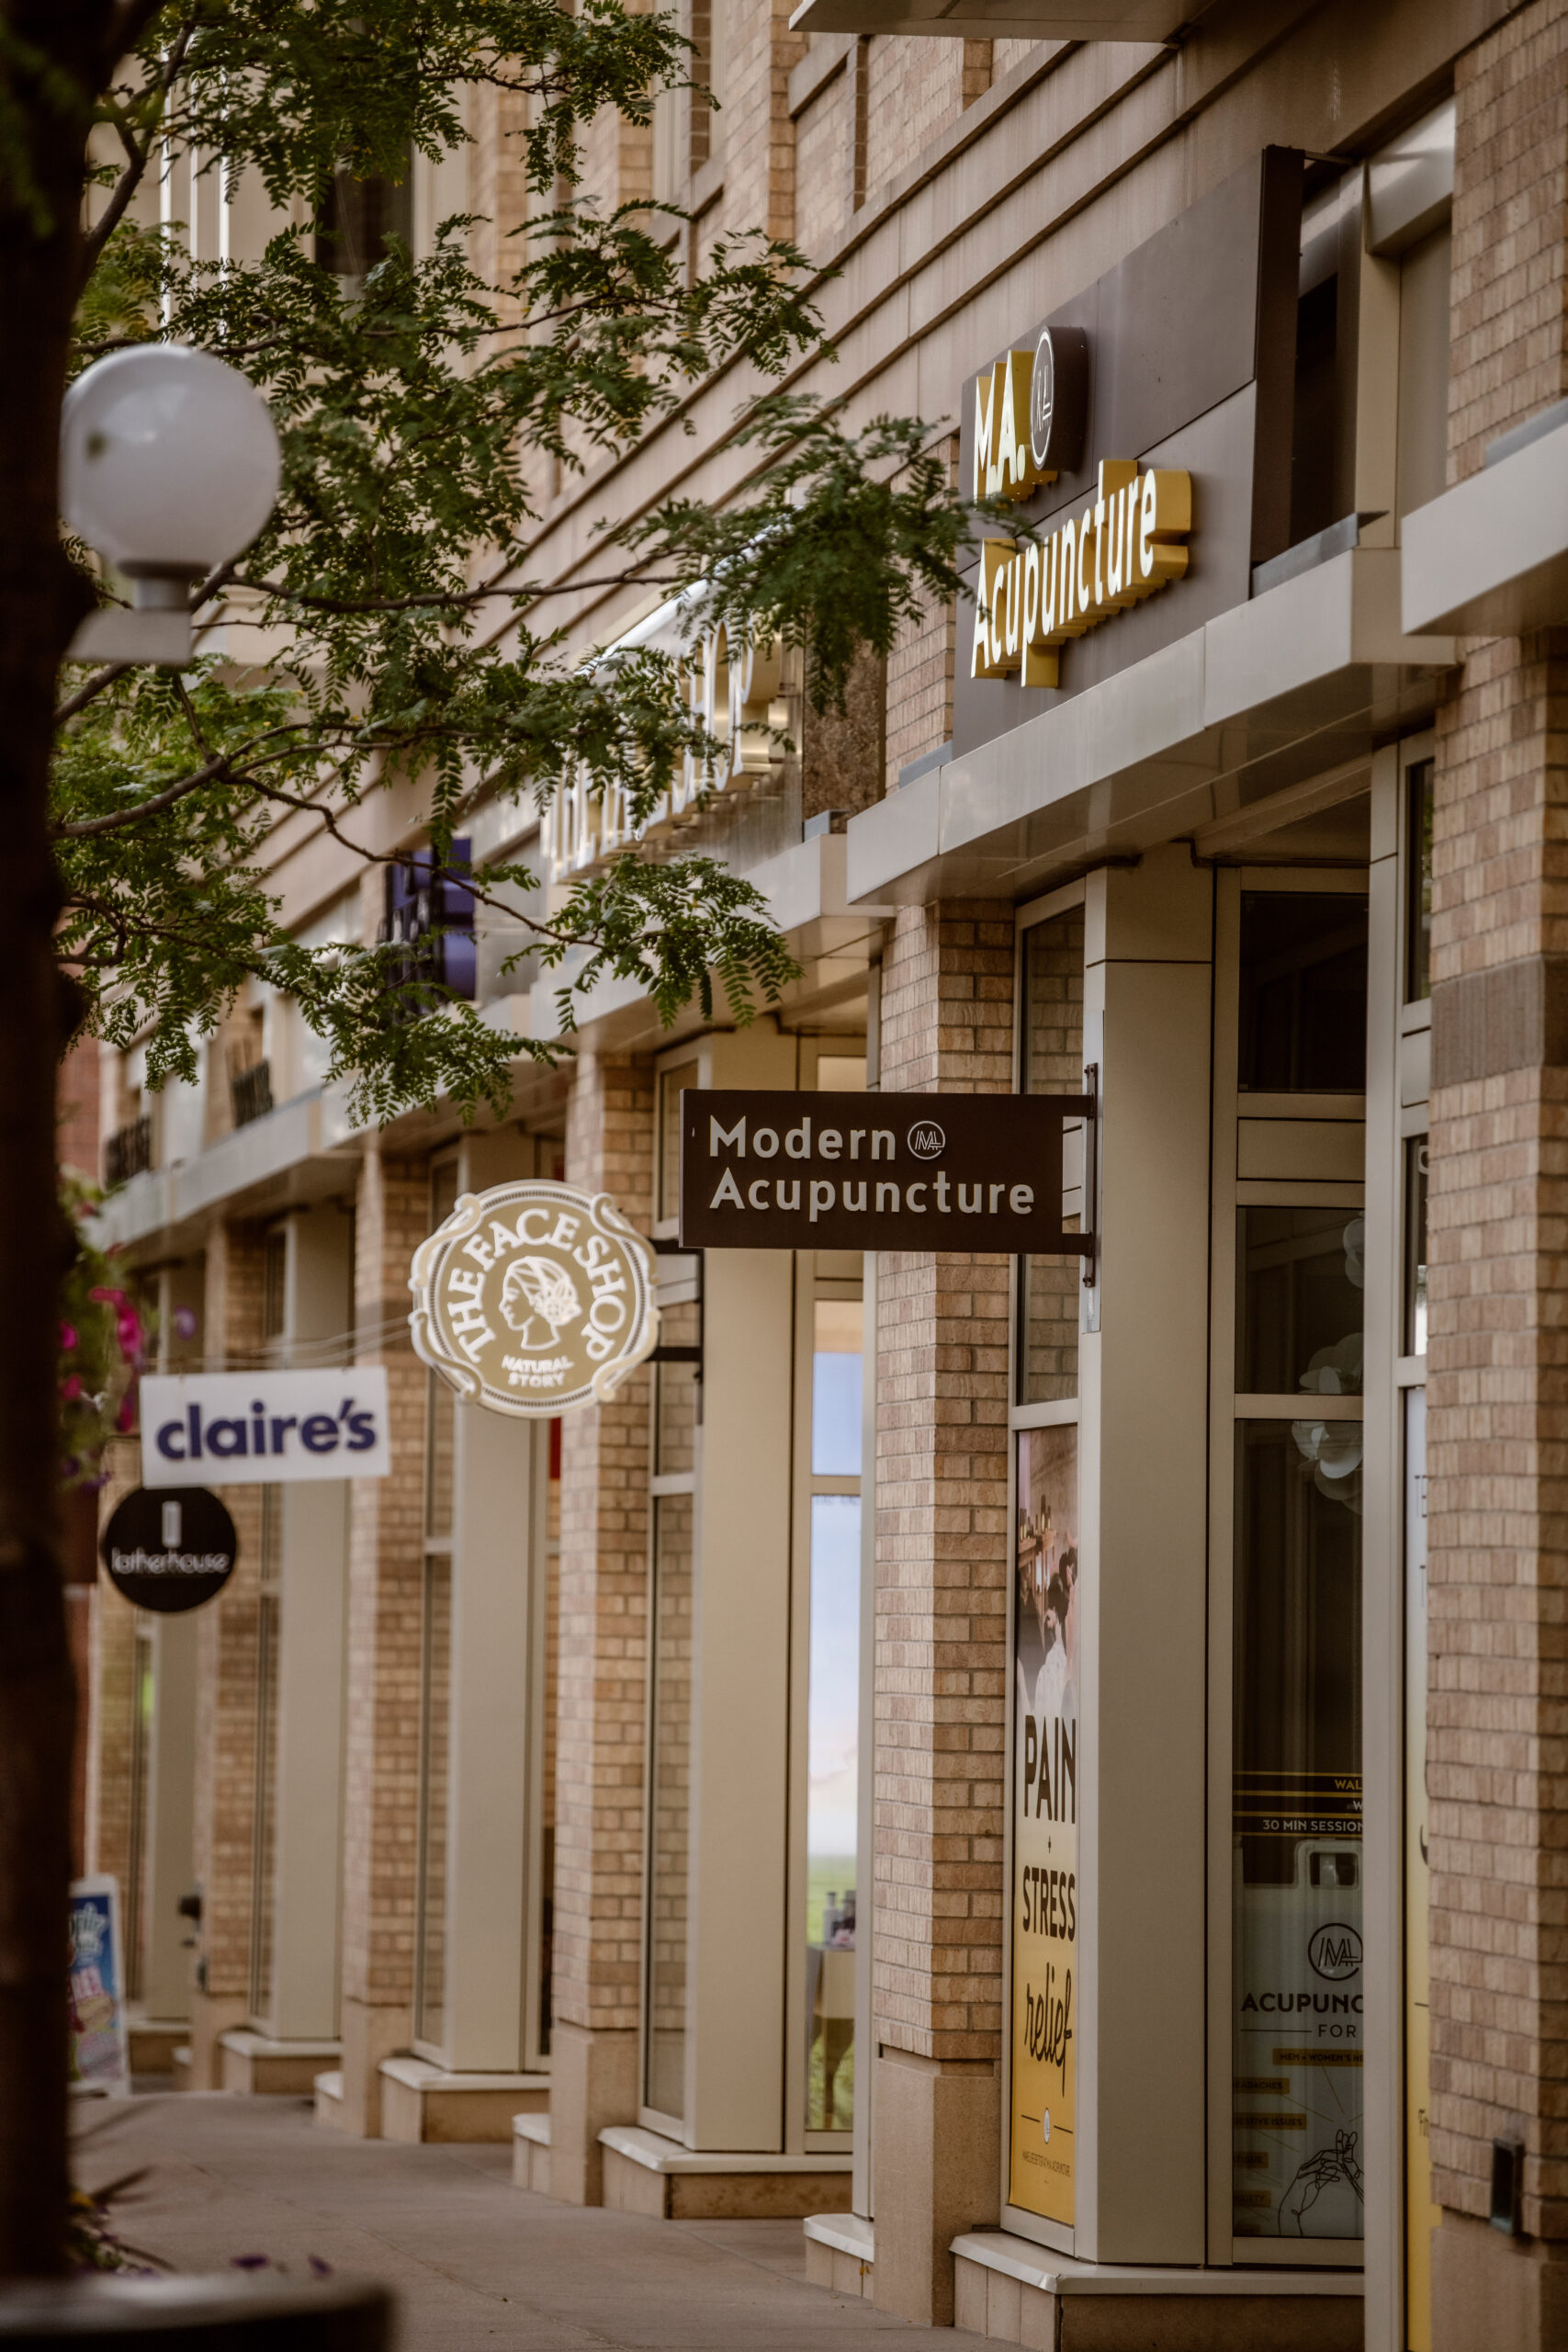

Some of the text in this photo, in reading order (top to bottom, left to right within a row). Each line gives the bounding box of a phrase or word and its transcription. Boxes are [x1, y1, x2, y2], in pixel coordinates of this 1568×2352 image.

[971, 459, 1157, 687] Acupuncture
[709, 1114, 897, 1160] Modern
[708, 1166, 1035, 1223] Acupuncture
[447, 1207, 628, 1363] THE FACE SHOP
[501, 1354, 575, 1374] NATURAL
[508, 1372, 567, 1388] STORY
[155, 1397, 377, 1460] claire's
[1024, 1714, 1077, 1825] PAIN
[1262, 1819, 1280, 1831] 30
[1282, 1820, 1307, 1831] MIN
[1022, 1864, 1076, 1942] STRESS
[1024, 1962, 1073, 2098] relief
[1240, 1992, 1363, 2014] ACUPUNC
[1318, 2024, 1357, 2038] FOR
